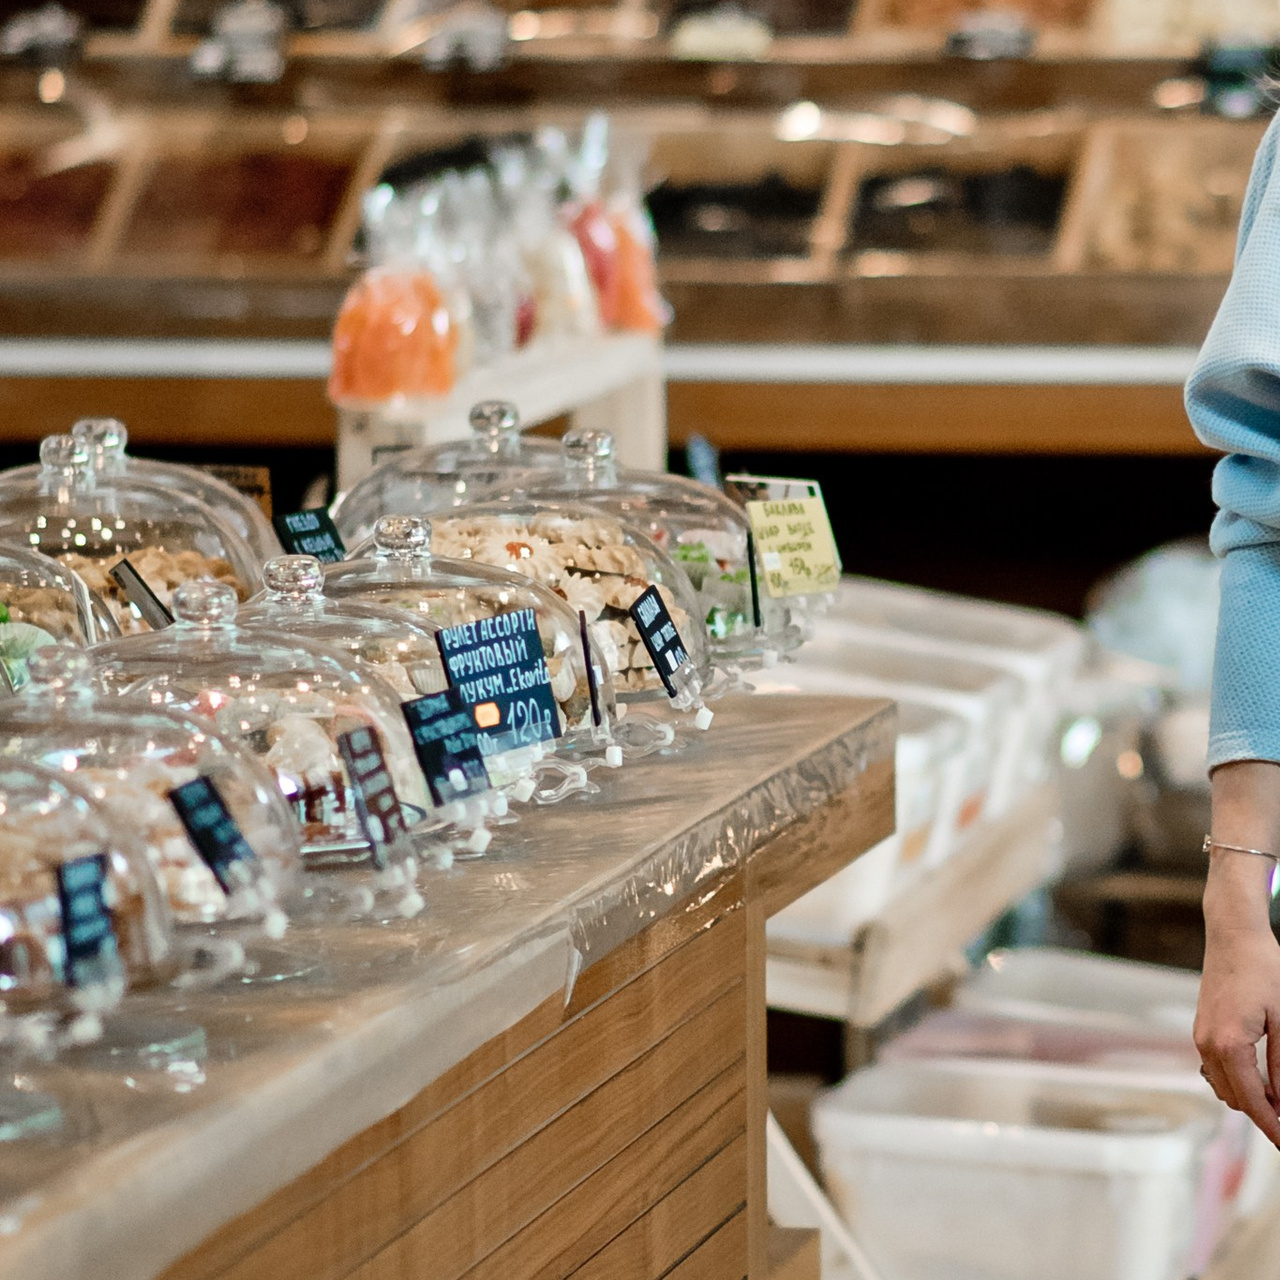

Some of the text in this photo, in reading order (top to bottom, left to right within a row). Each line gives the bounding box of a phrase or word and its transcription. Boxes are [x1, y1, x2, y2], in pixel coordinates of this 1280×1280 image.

[442, 608, 536, 650] РУЛЕТ АССОРТИ
[448, 635, 528, 678] ФРУКТОВЫЙ
[459, 672, 505, 703] ЛУКУМ
